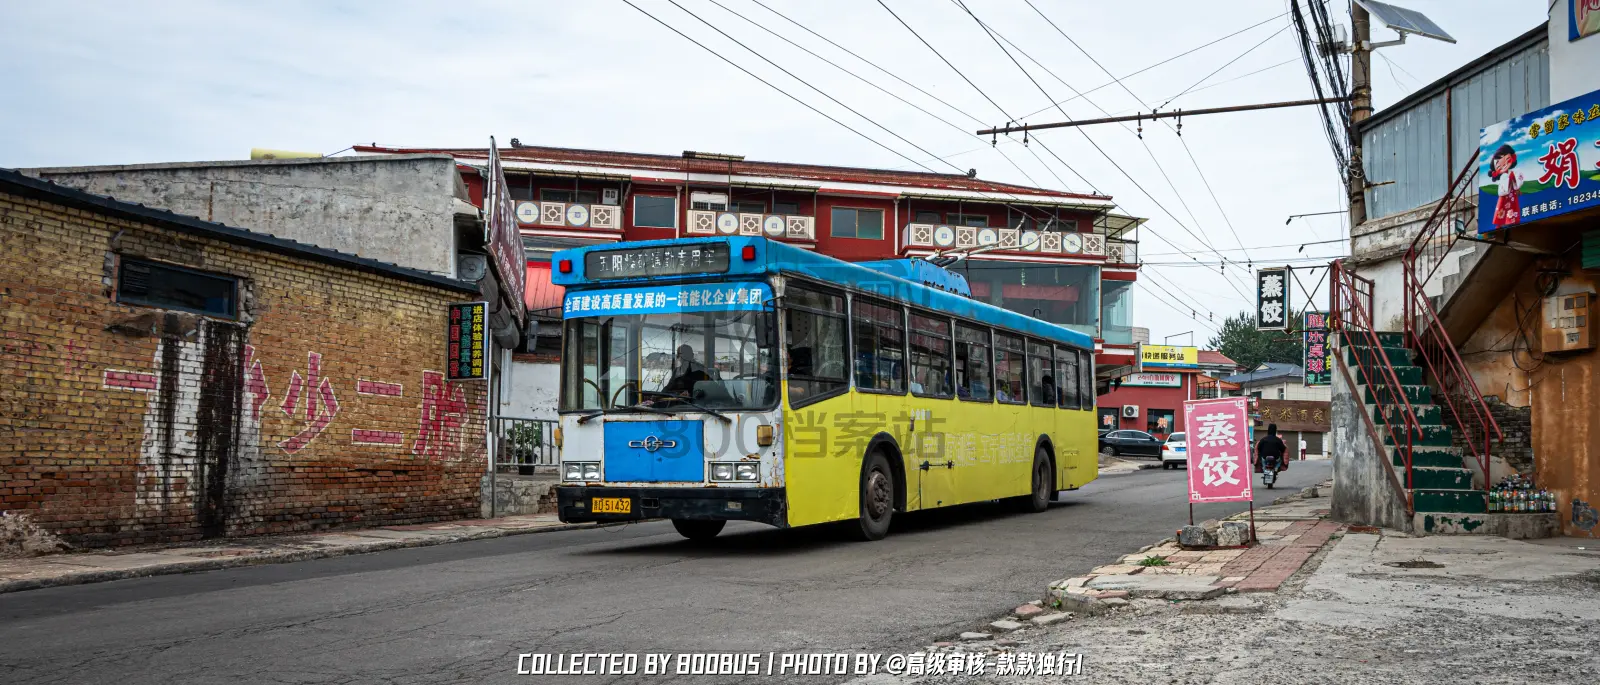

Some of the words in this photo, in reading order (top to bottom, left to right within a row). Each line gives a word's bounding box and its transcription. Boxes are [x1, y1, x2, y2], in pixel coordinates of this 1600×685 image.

[1538, 137, 1600, 189] 娟
[565, 288, 762, 314] 全面建设高质量发展的一流能化企业集团
[1260, 274, 1283, 324] 蒸饺
[472, 305, 483, 376] 进店体验温养调理
[1196, 412, 1241, 487] 蒸饺
